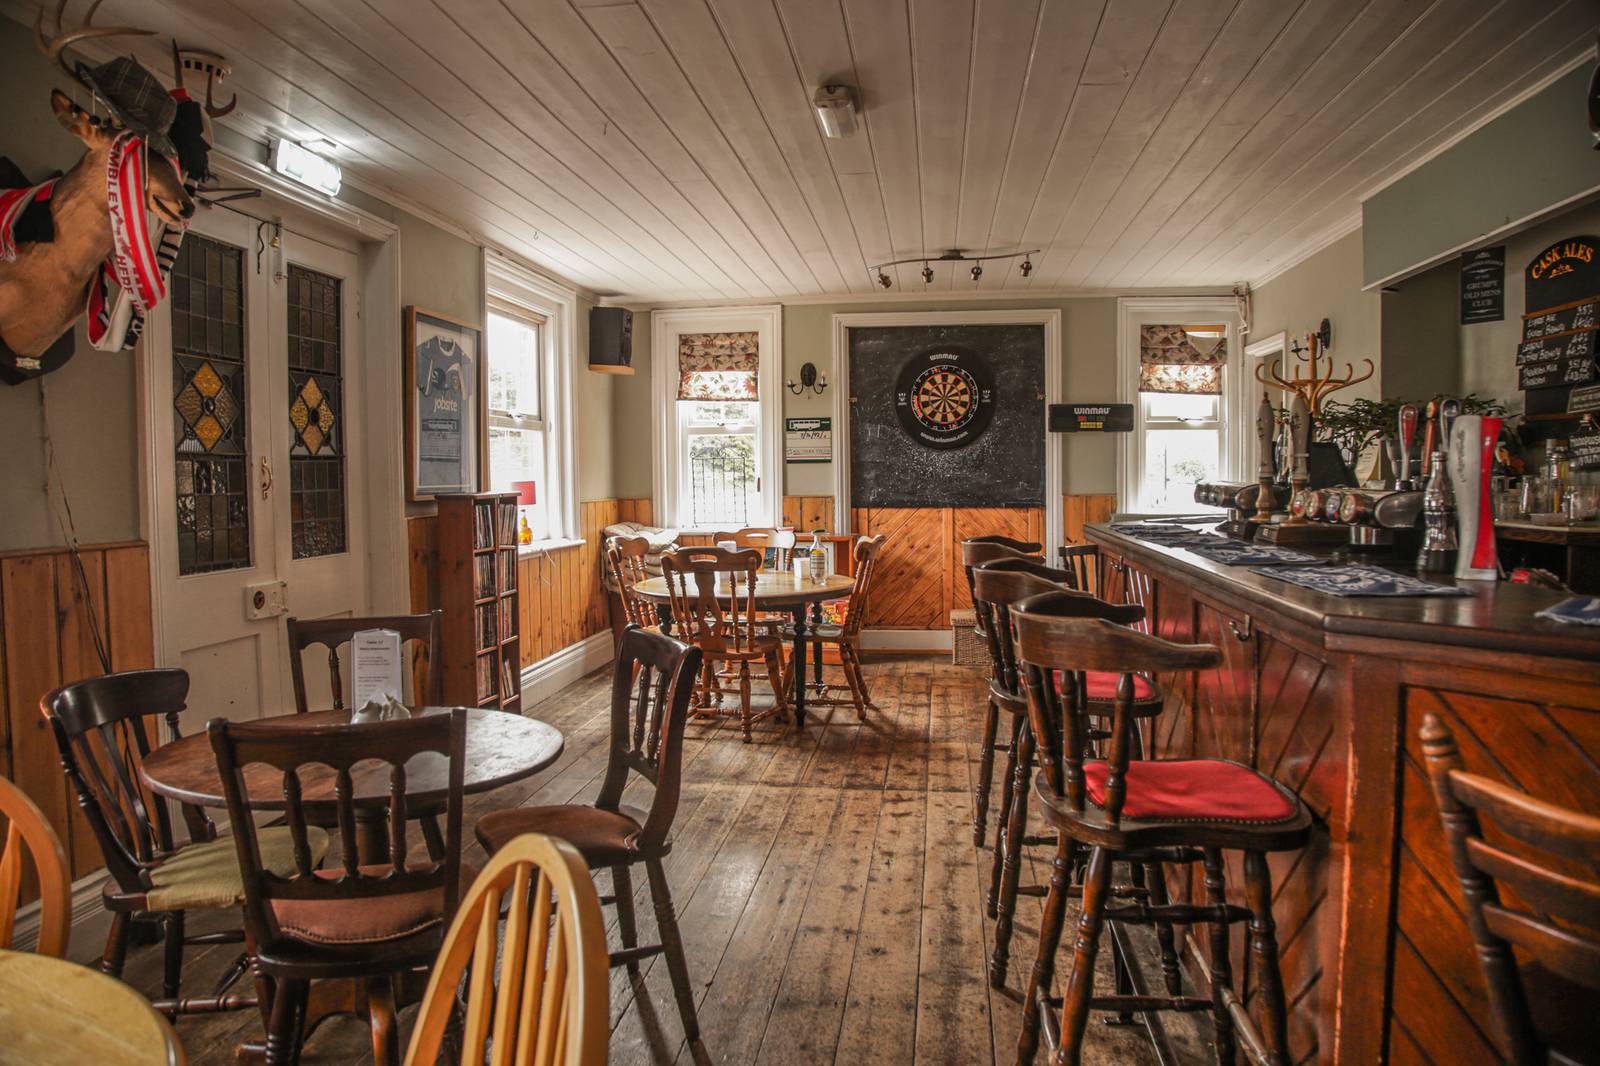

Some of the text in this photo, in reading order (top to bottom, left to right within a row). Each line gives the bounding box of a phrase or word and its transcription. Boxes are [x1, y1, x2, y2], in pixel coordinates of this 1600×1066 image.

[1532, 246, 1561, 279] CASK
[1563, 243, 1594, 263] ALES
[1466, 280, 1498, 290] GRUMPY
[1464, 290, 1480, 300] OLD
[1472, 299, 1493, 307] CLUB
[433, 397, 458, 413] jobsite
[1073, 407, 1110, 415] WINMAU
